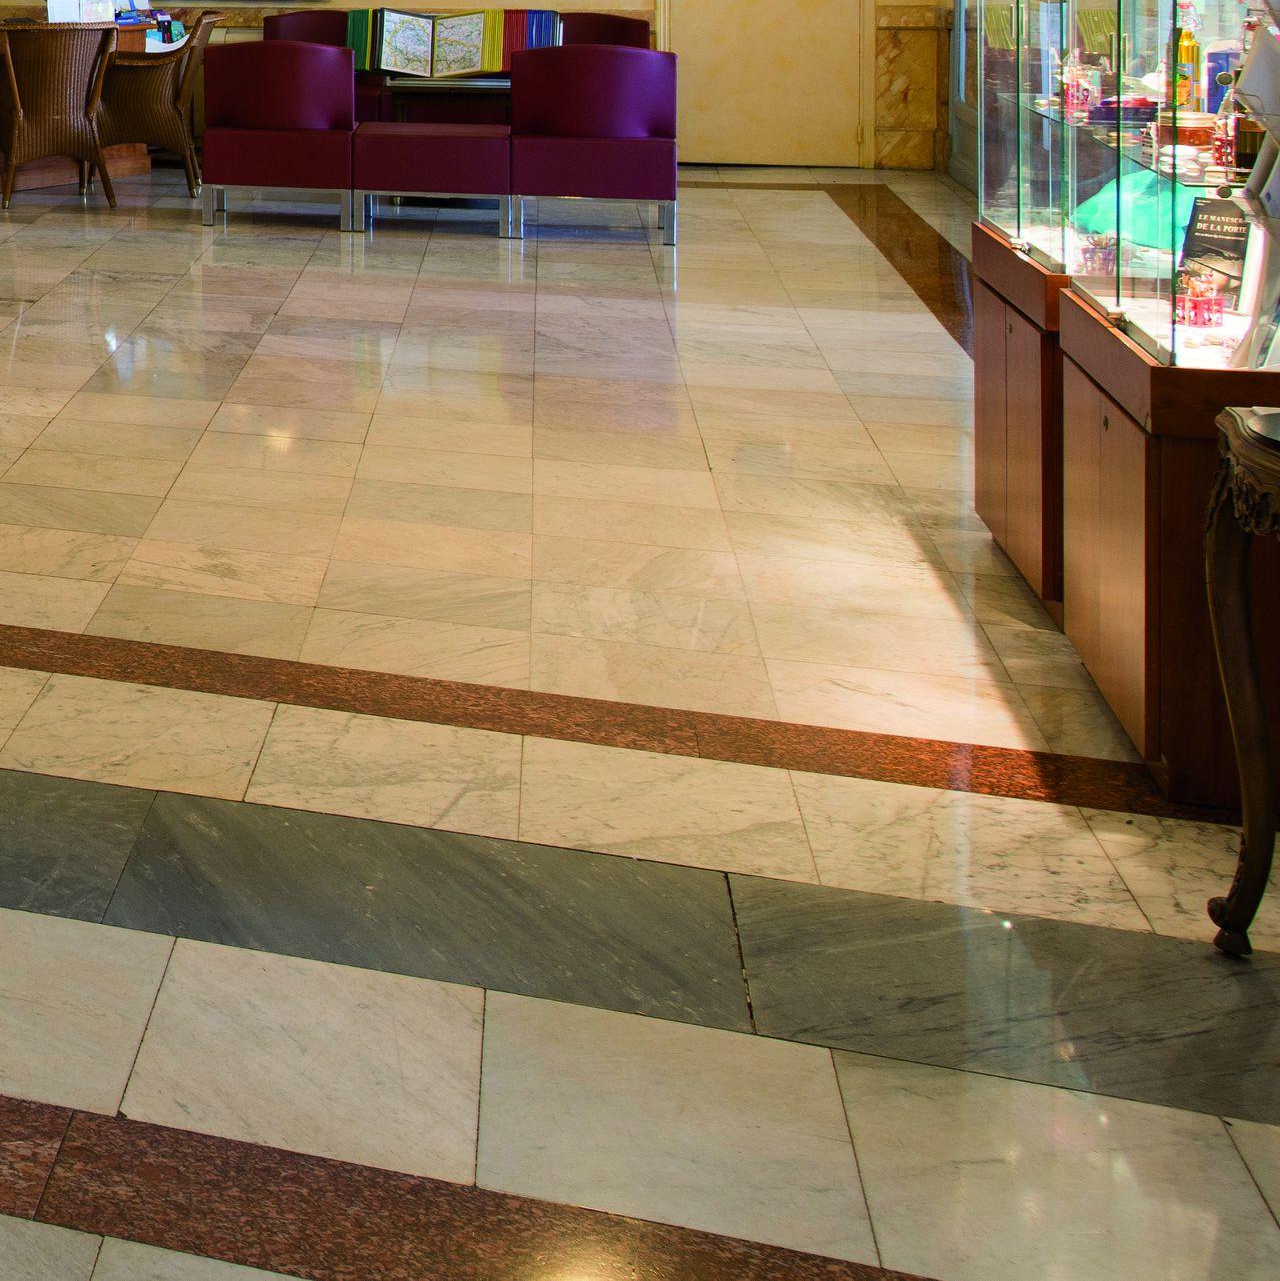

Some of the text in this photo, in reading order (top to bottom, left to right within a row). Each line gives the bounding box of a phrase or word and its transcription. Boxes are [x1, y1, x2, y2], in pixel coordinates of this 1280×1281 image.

[1198, 213, 1209, 221] LE
[1196, 222, 1208, 230] DE
[1210, 223, 1221, 232] LA
